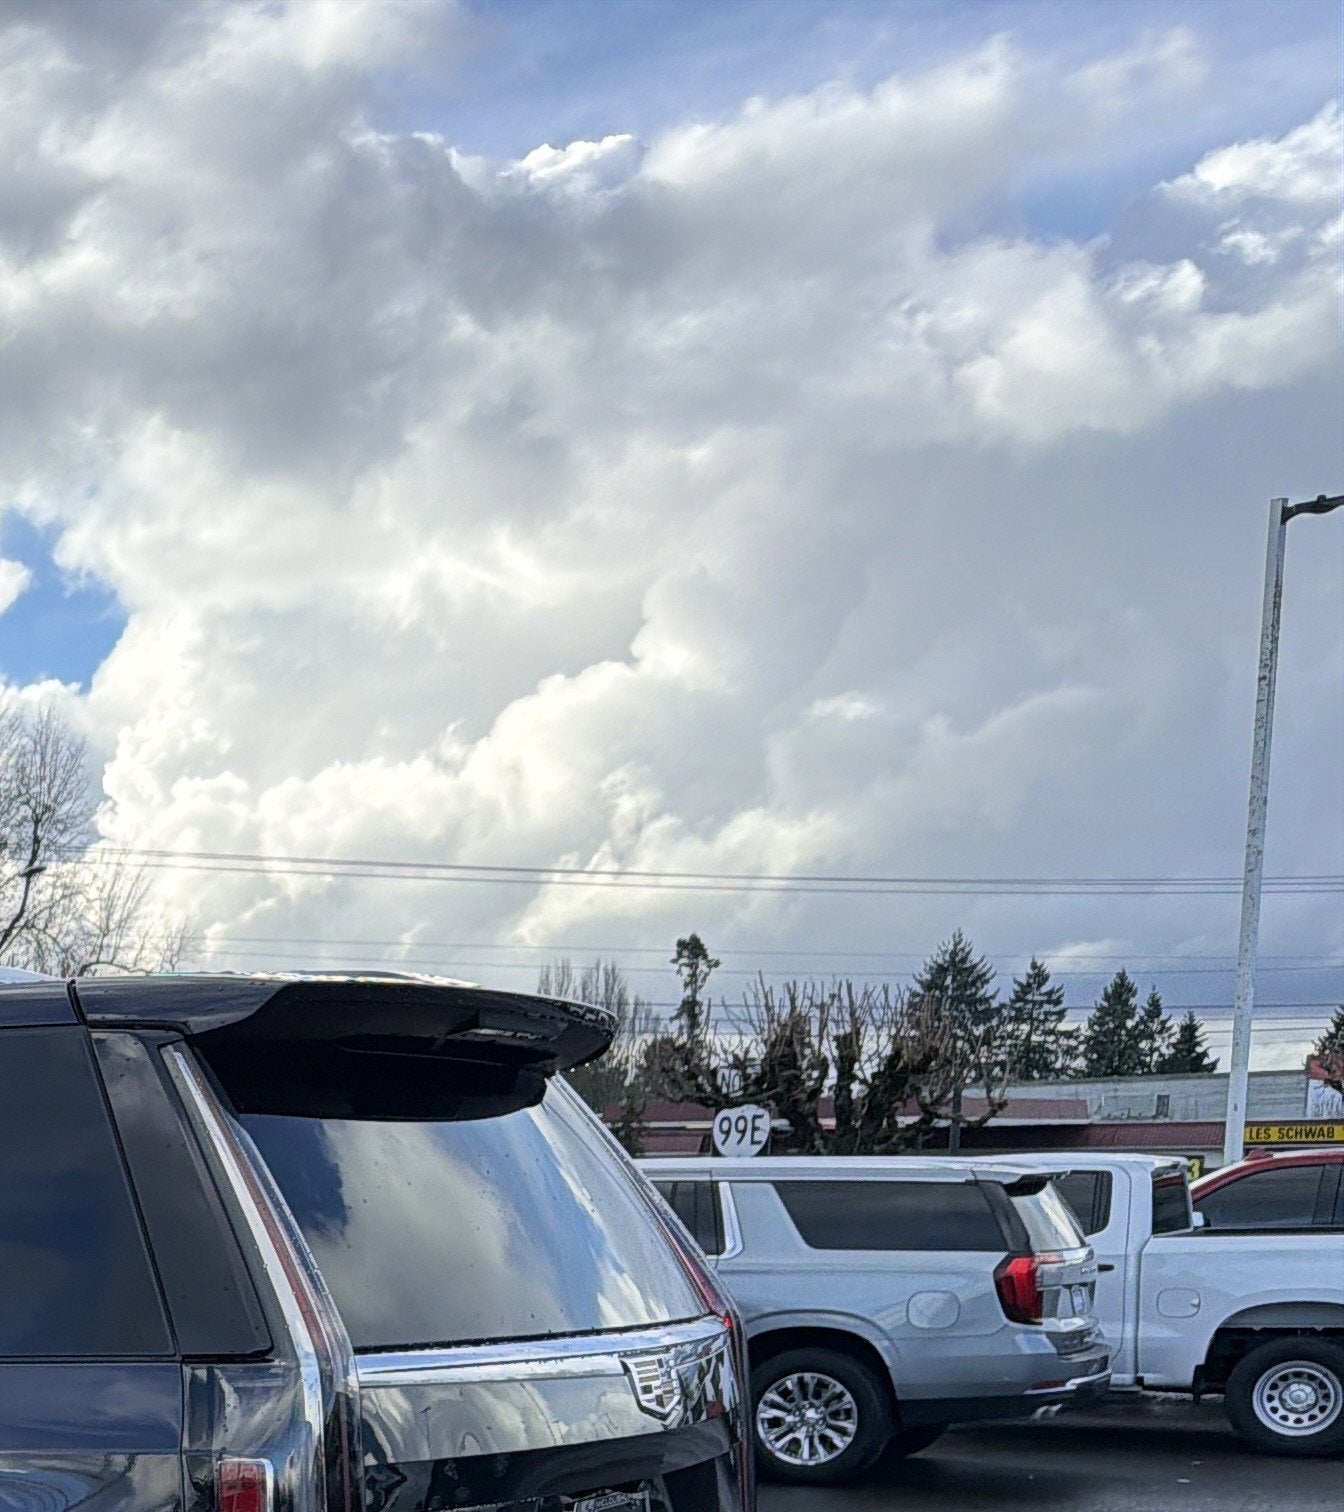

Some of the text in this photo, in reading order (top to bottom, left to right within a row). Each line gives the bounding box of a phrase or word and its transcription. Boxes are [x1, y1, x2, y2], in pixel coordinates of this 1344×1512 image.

[718, 1113, 765, 1147] 99E
[1248, 1126, 1335, 1141] LES SCHWAB
